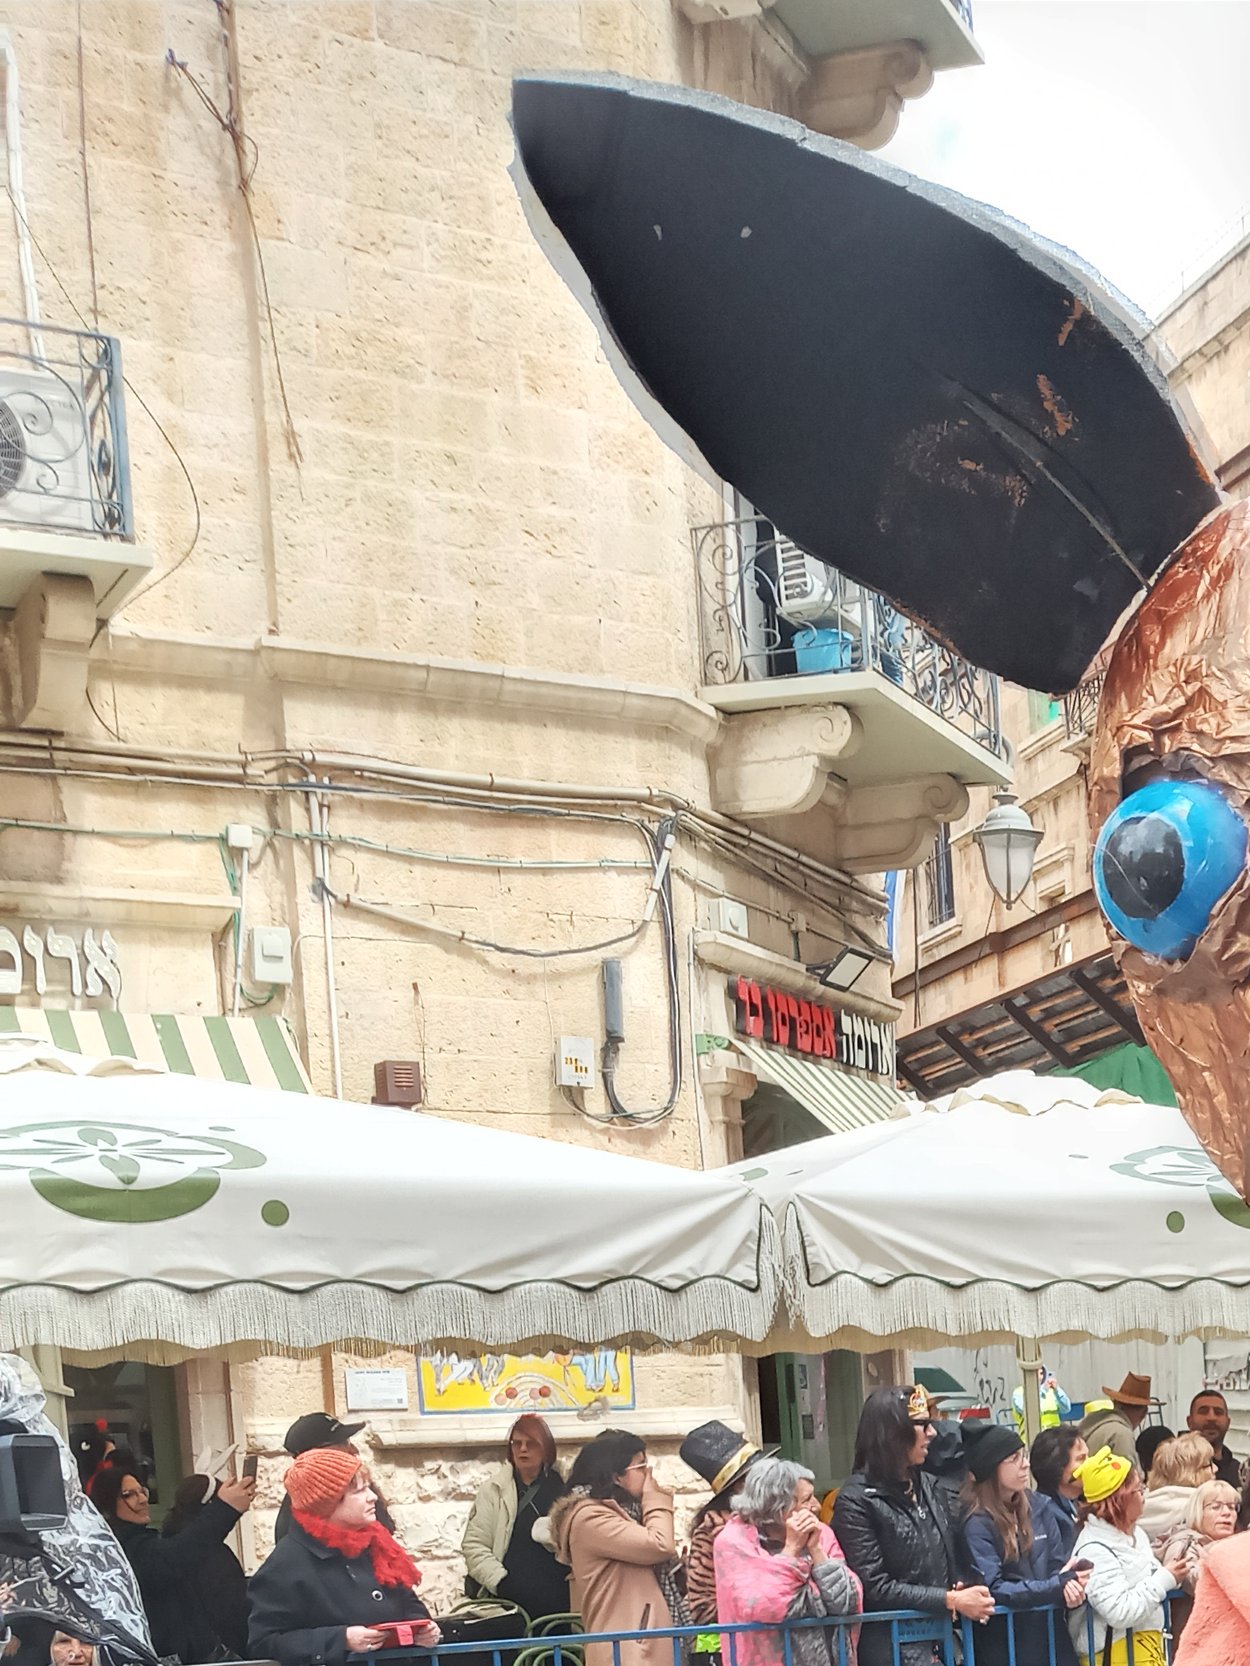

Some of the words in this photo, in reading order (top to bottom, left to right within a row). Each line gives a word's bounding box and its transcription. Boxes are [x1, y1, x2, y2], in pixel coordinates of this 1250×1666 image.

[737, 973, 764, 1038] בר
[767, 985, 836, 1059] אספרסו
[841, 1008, 893, 1076] ארומה
